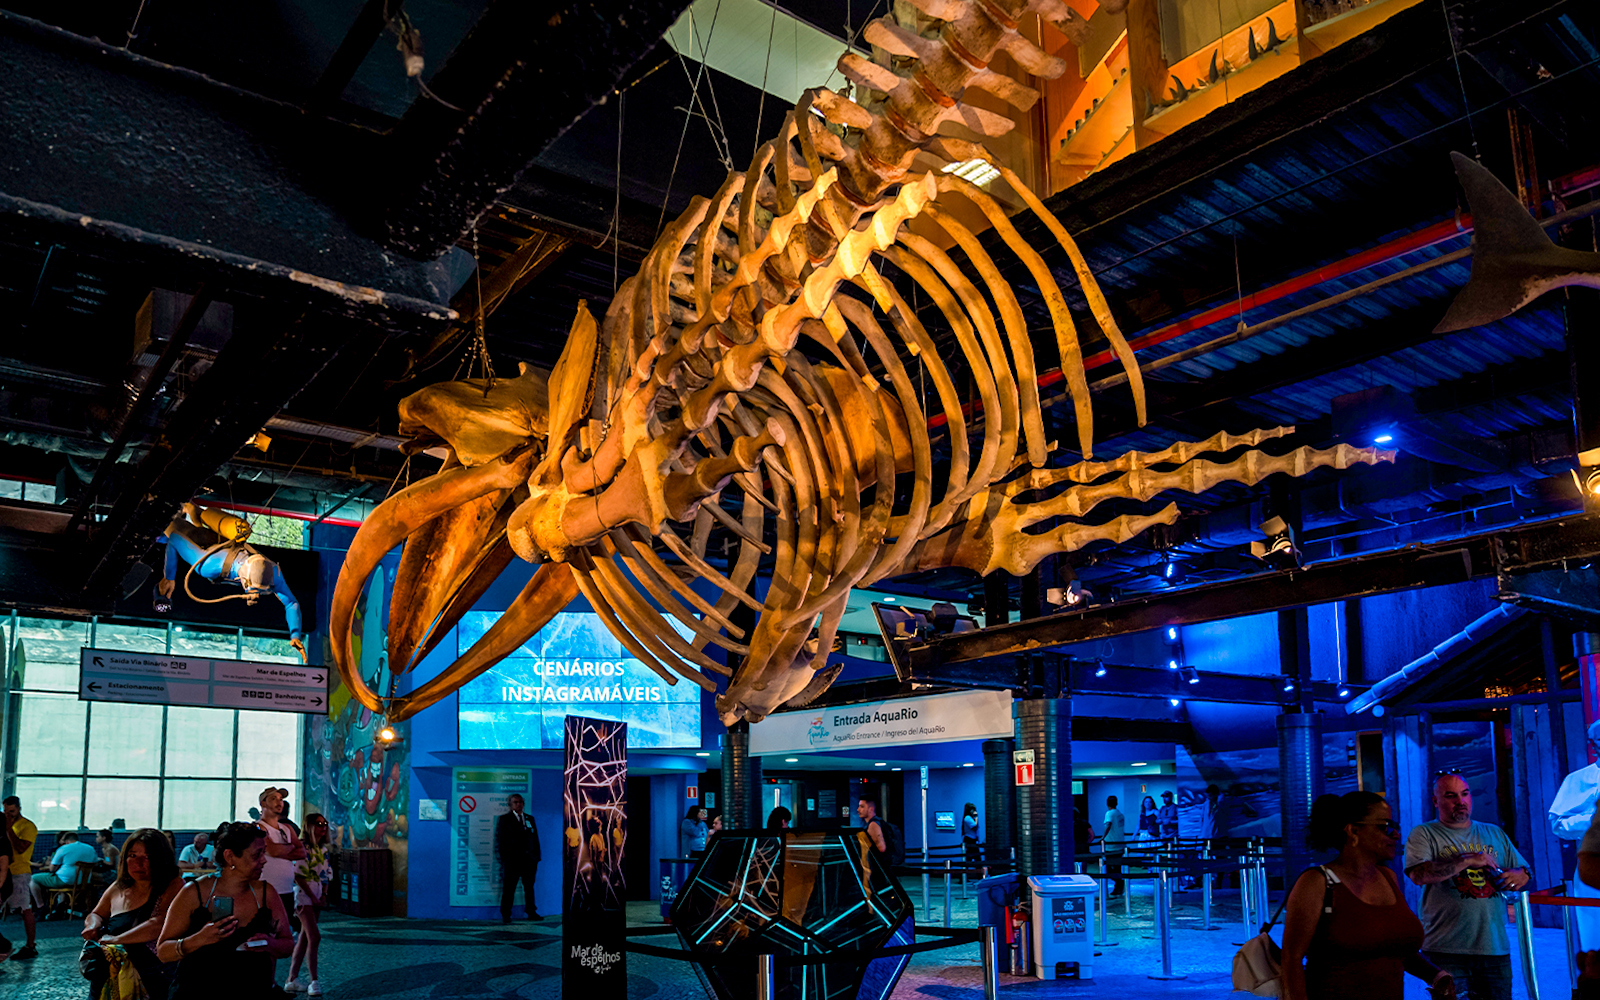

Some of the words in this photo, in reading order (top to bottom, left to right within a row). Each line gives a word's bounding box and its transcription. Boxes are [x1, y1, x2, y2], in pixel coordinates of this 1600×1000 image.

[533, 657, 625, 677] CENÁRIOS
[108, 682, 164, 691] Estacionamento
[502, 683, 661, 702] INSTAGRAMÁVEIS
[834, 713, 871, 726] Entrada
[873, 708, 919, 724] AquaRio
[833, 732, 856, 742] AquaRio
[856, 731, 881, 740] Entrance
[885, 729, 908, 739] Ingreso
[908, 727, 919, 735] del
[919, 725, 945, 736] AquaRio
[571, 945, 591, 958] Mar
[591, 943, 604, 956] de
[581, 951, 620, 968] espelhos
